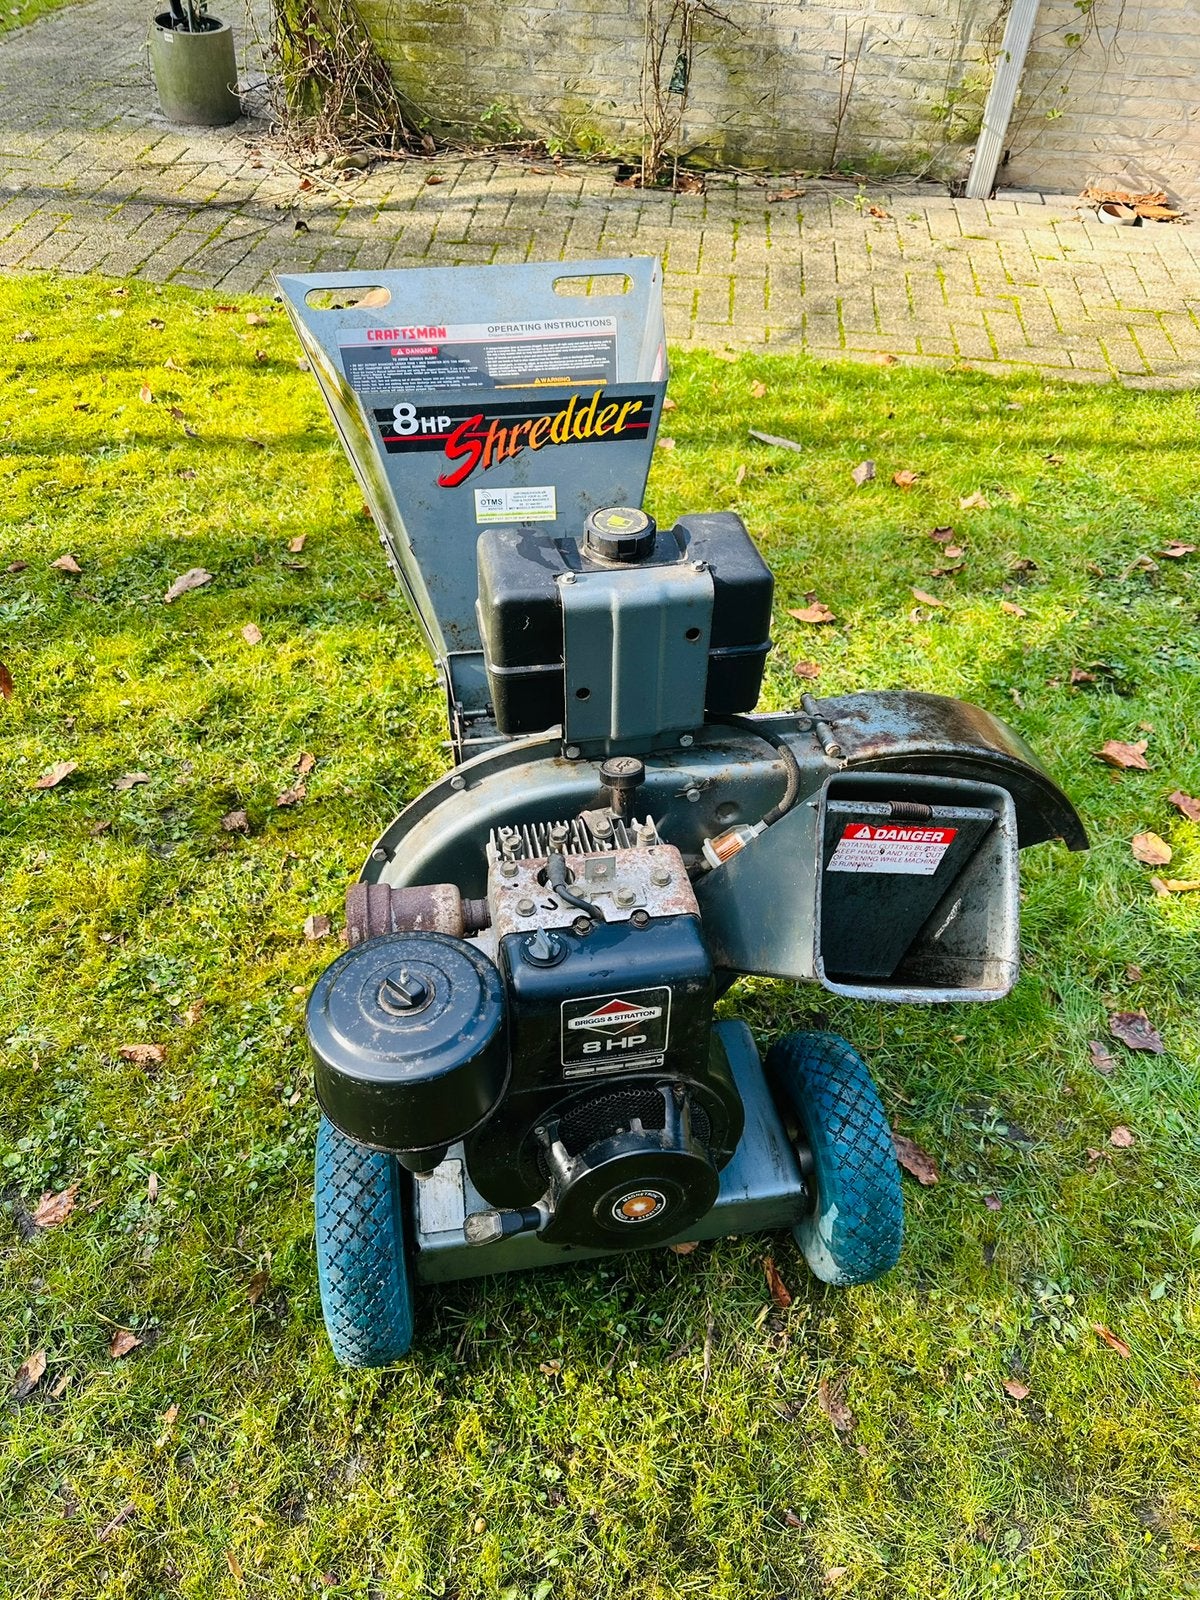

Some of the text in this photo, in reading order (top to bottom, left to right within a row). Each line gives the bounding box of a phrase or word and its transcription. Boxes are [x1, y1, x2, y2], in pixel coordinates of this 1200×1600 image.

[487, 318, 612, 334] OPERATING INSTRUCTIONS
[367, 326, 447, 341] CRAFTSMAN
[405, 347, 433, 355] DANGER
[540, 376, 571, 384] WARNING
[437, 389, 643, 488] Shredder
[480, 498, 503, 506] OTMS
[873, 829, 945, 843] DANGER
[839, 841, 877, 849] ROTATING
[878, 843, 913, 851] CUTTING
[839, 860, 874, 868] RUNNING
[844, 854, 879, 862] OPENING
[904, 857, 939, 865] MACHINE
[574, 1016, 606, 1027] BRIGGS
[614, 1009, 656, 1021] STRATTON
[582, 1034, 647, 1054] 8 HP
